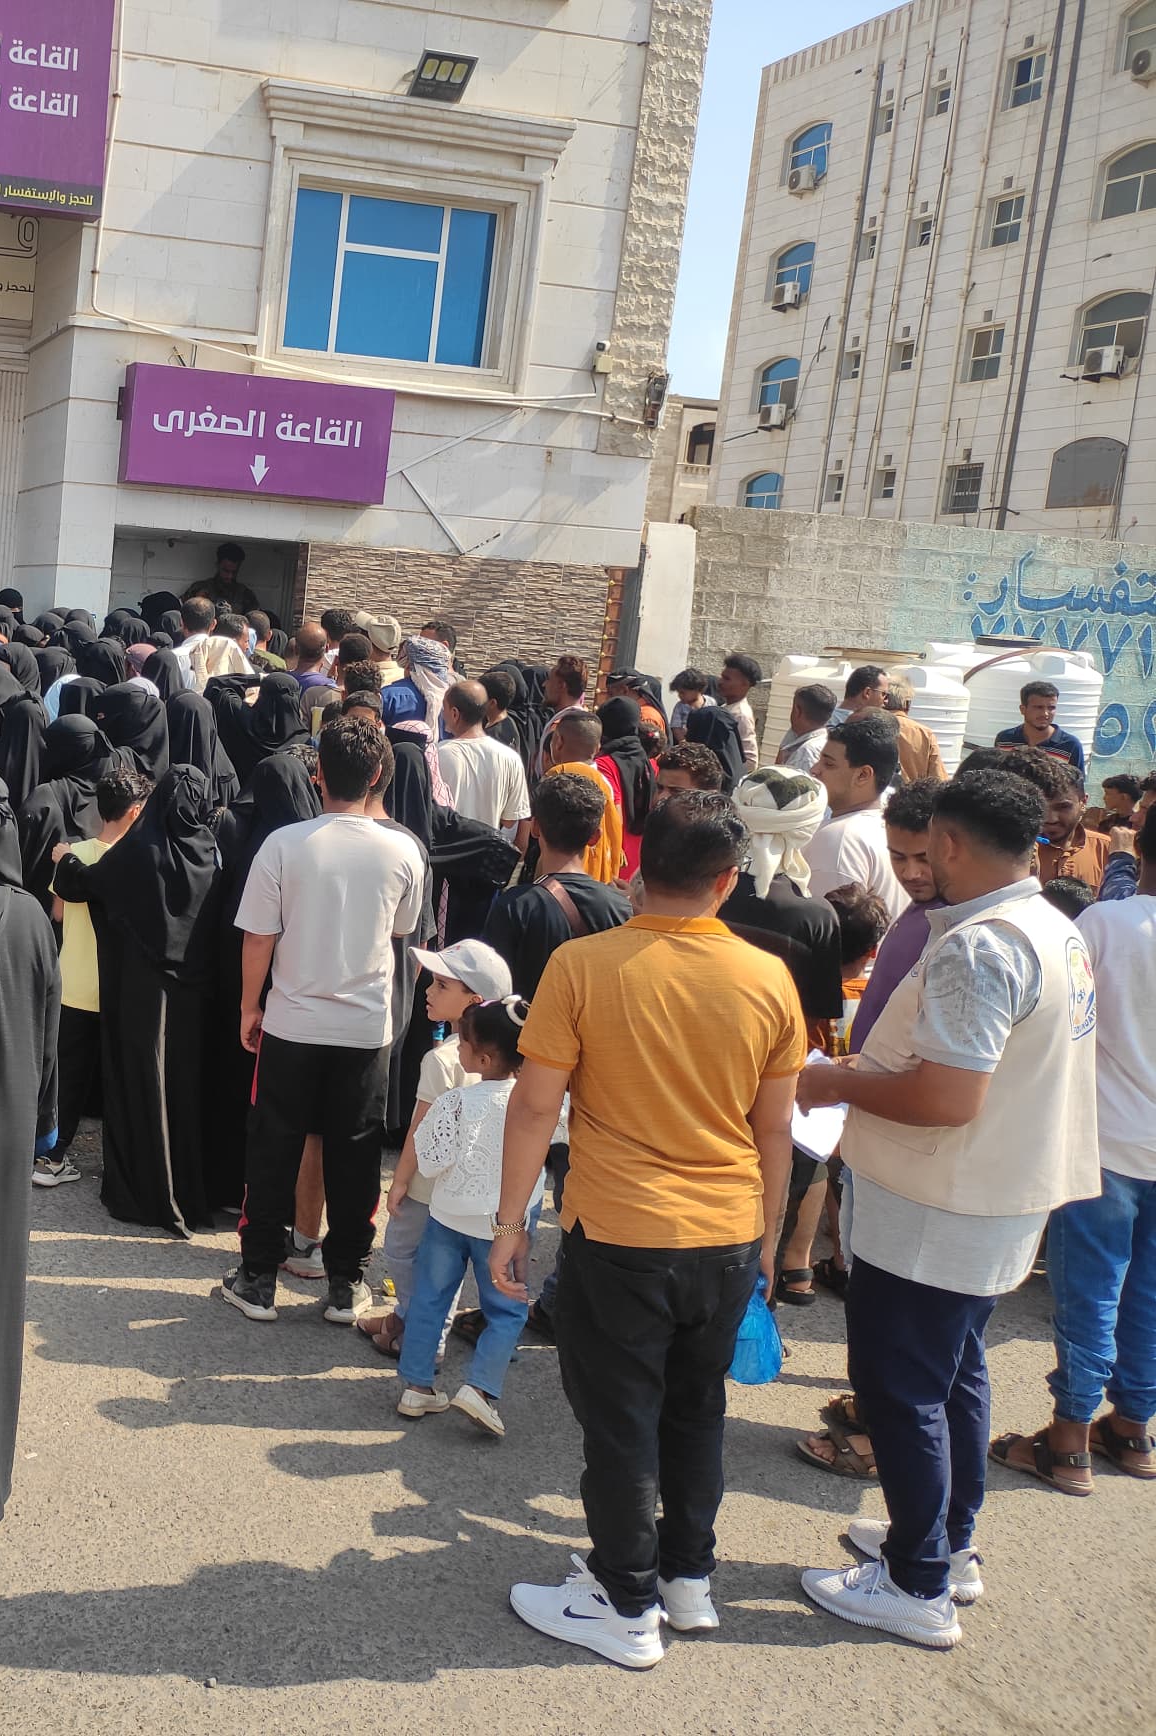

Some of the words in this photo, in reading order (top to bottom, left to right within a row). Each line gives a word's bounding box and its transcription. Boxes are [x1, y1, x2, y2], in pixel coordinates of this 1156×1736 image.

[8, 39, 79, 72] القاعة
[8, 86, 79, 118] القاعة
[3, 184, 66, 203] والإستفسار
[68, 192, 94, 206] للحجز
[152, 405, 266, 438] الصغرى
[275, 412, 362, 448] القاعة
